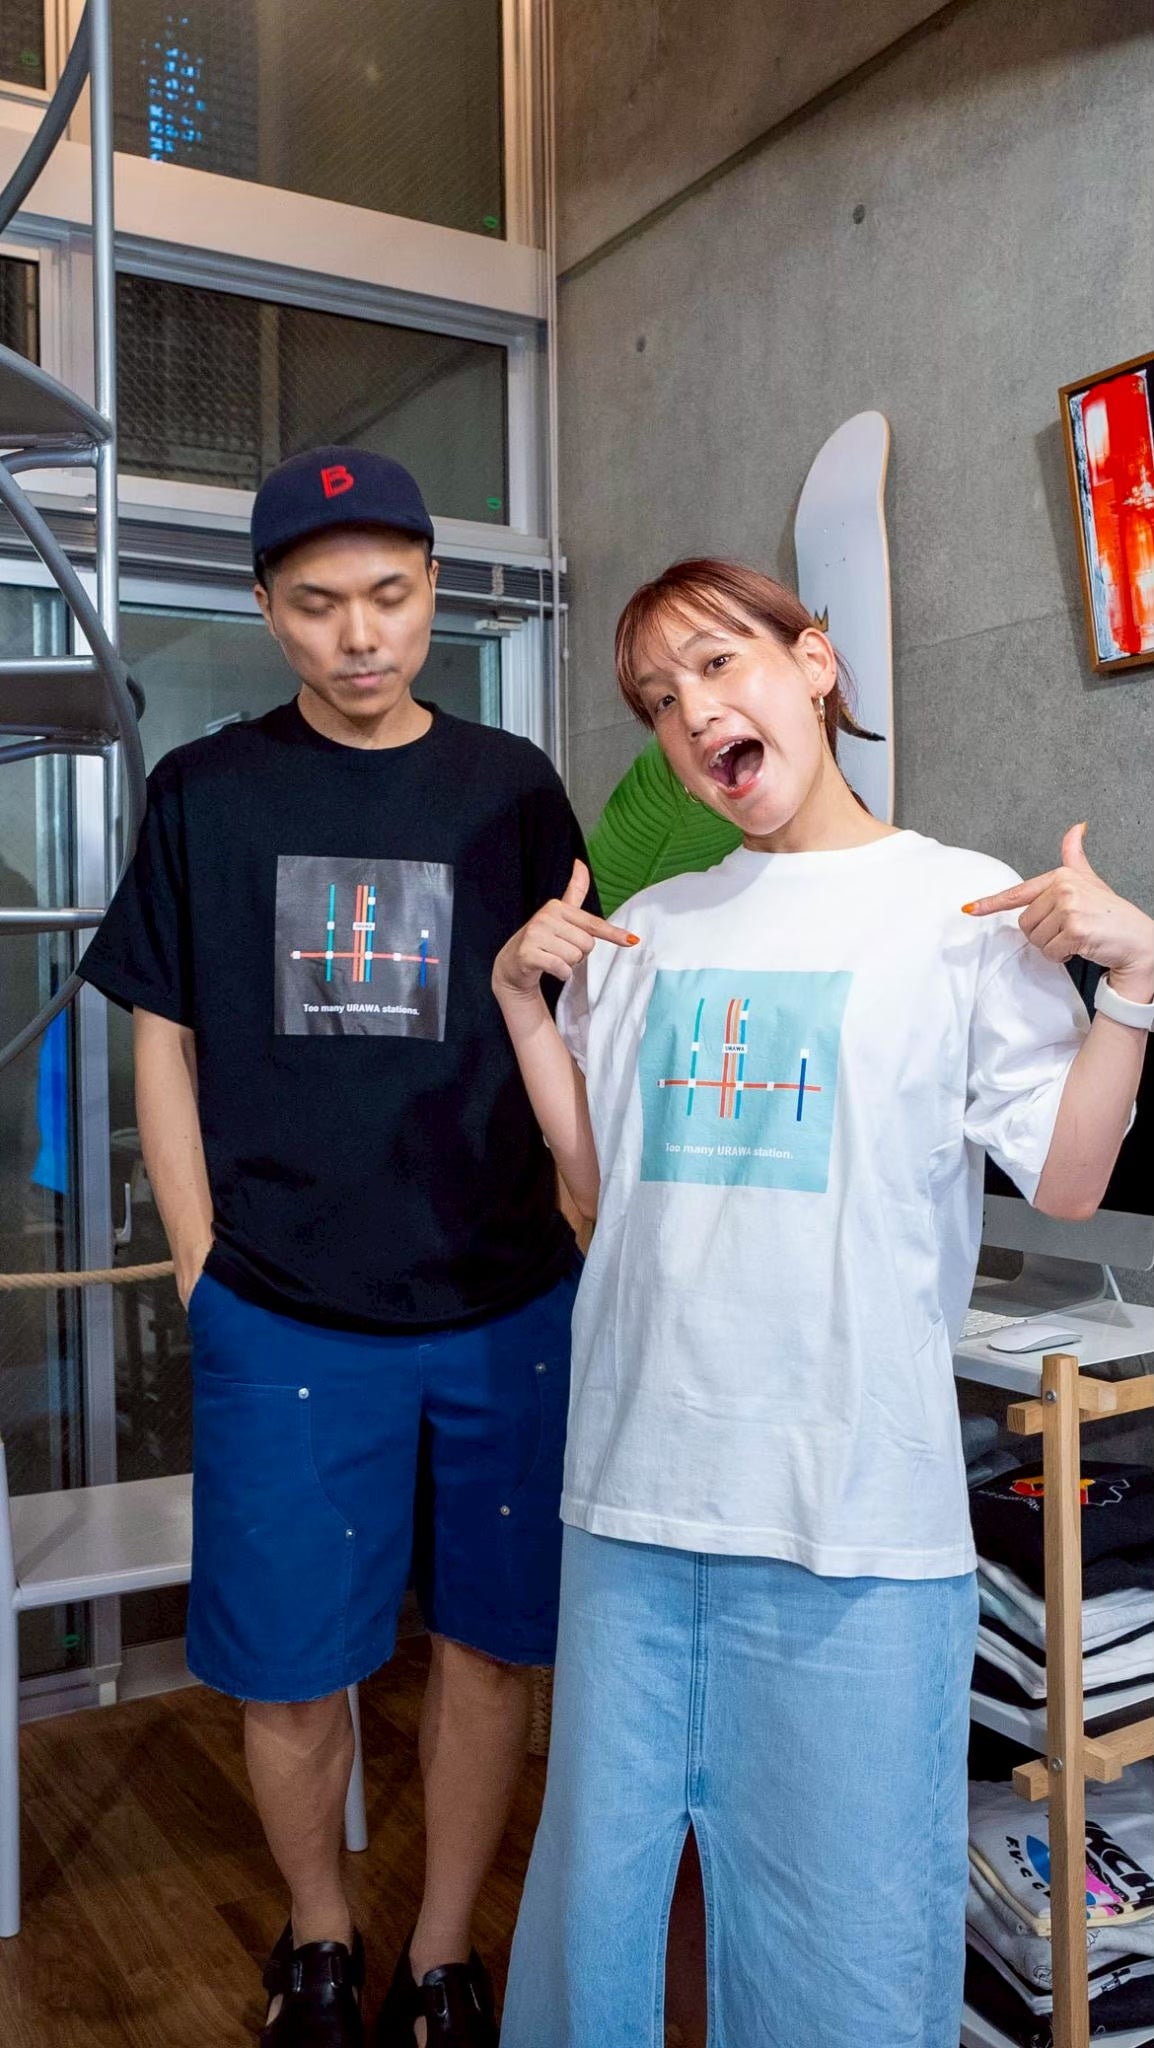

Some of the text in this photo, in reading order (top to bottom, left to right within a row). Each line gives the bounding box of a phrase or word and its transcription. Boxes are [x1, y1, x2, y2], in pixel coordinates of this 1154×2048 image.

[321, 465, 354, 499] B
[303, 1003, 420, 1016] Too many URAWA stations.
[665, 1142, 794, 1159] Too many URAWA station.
